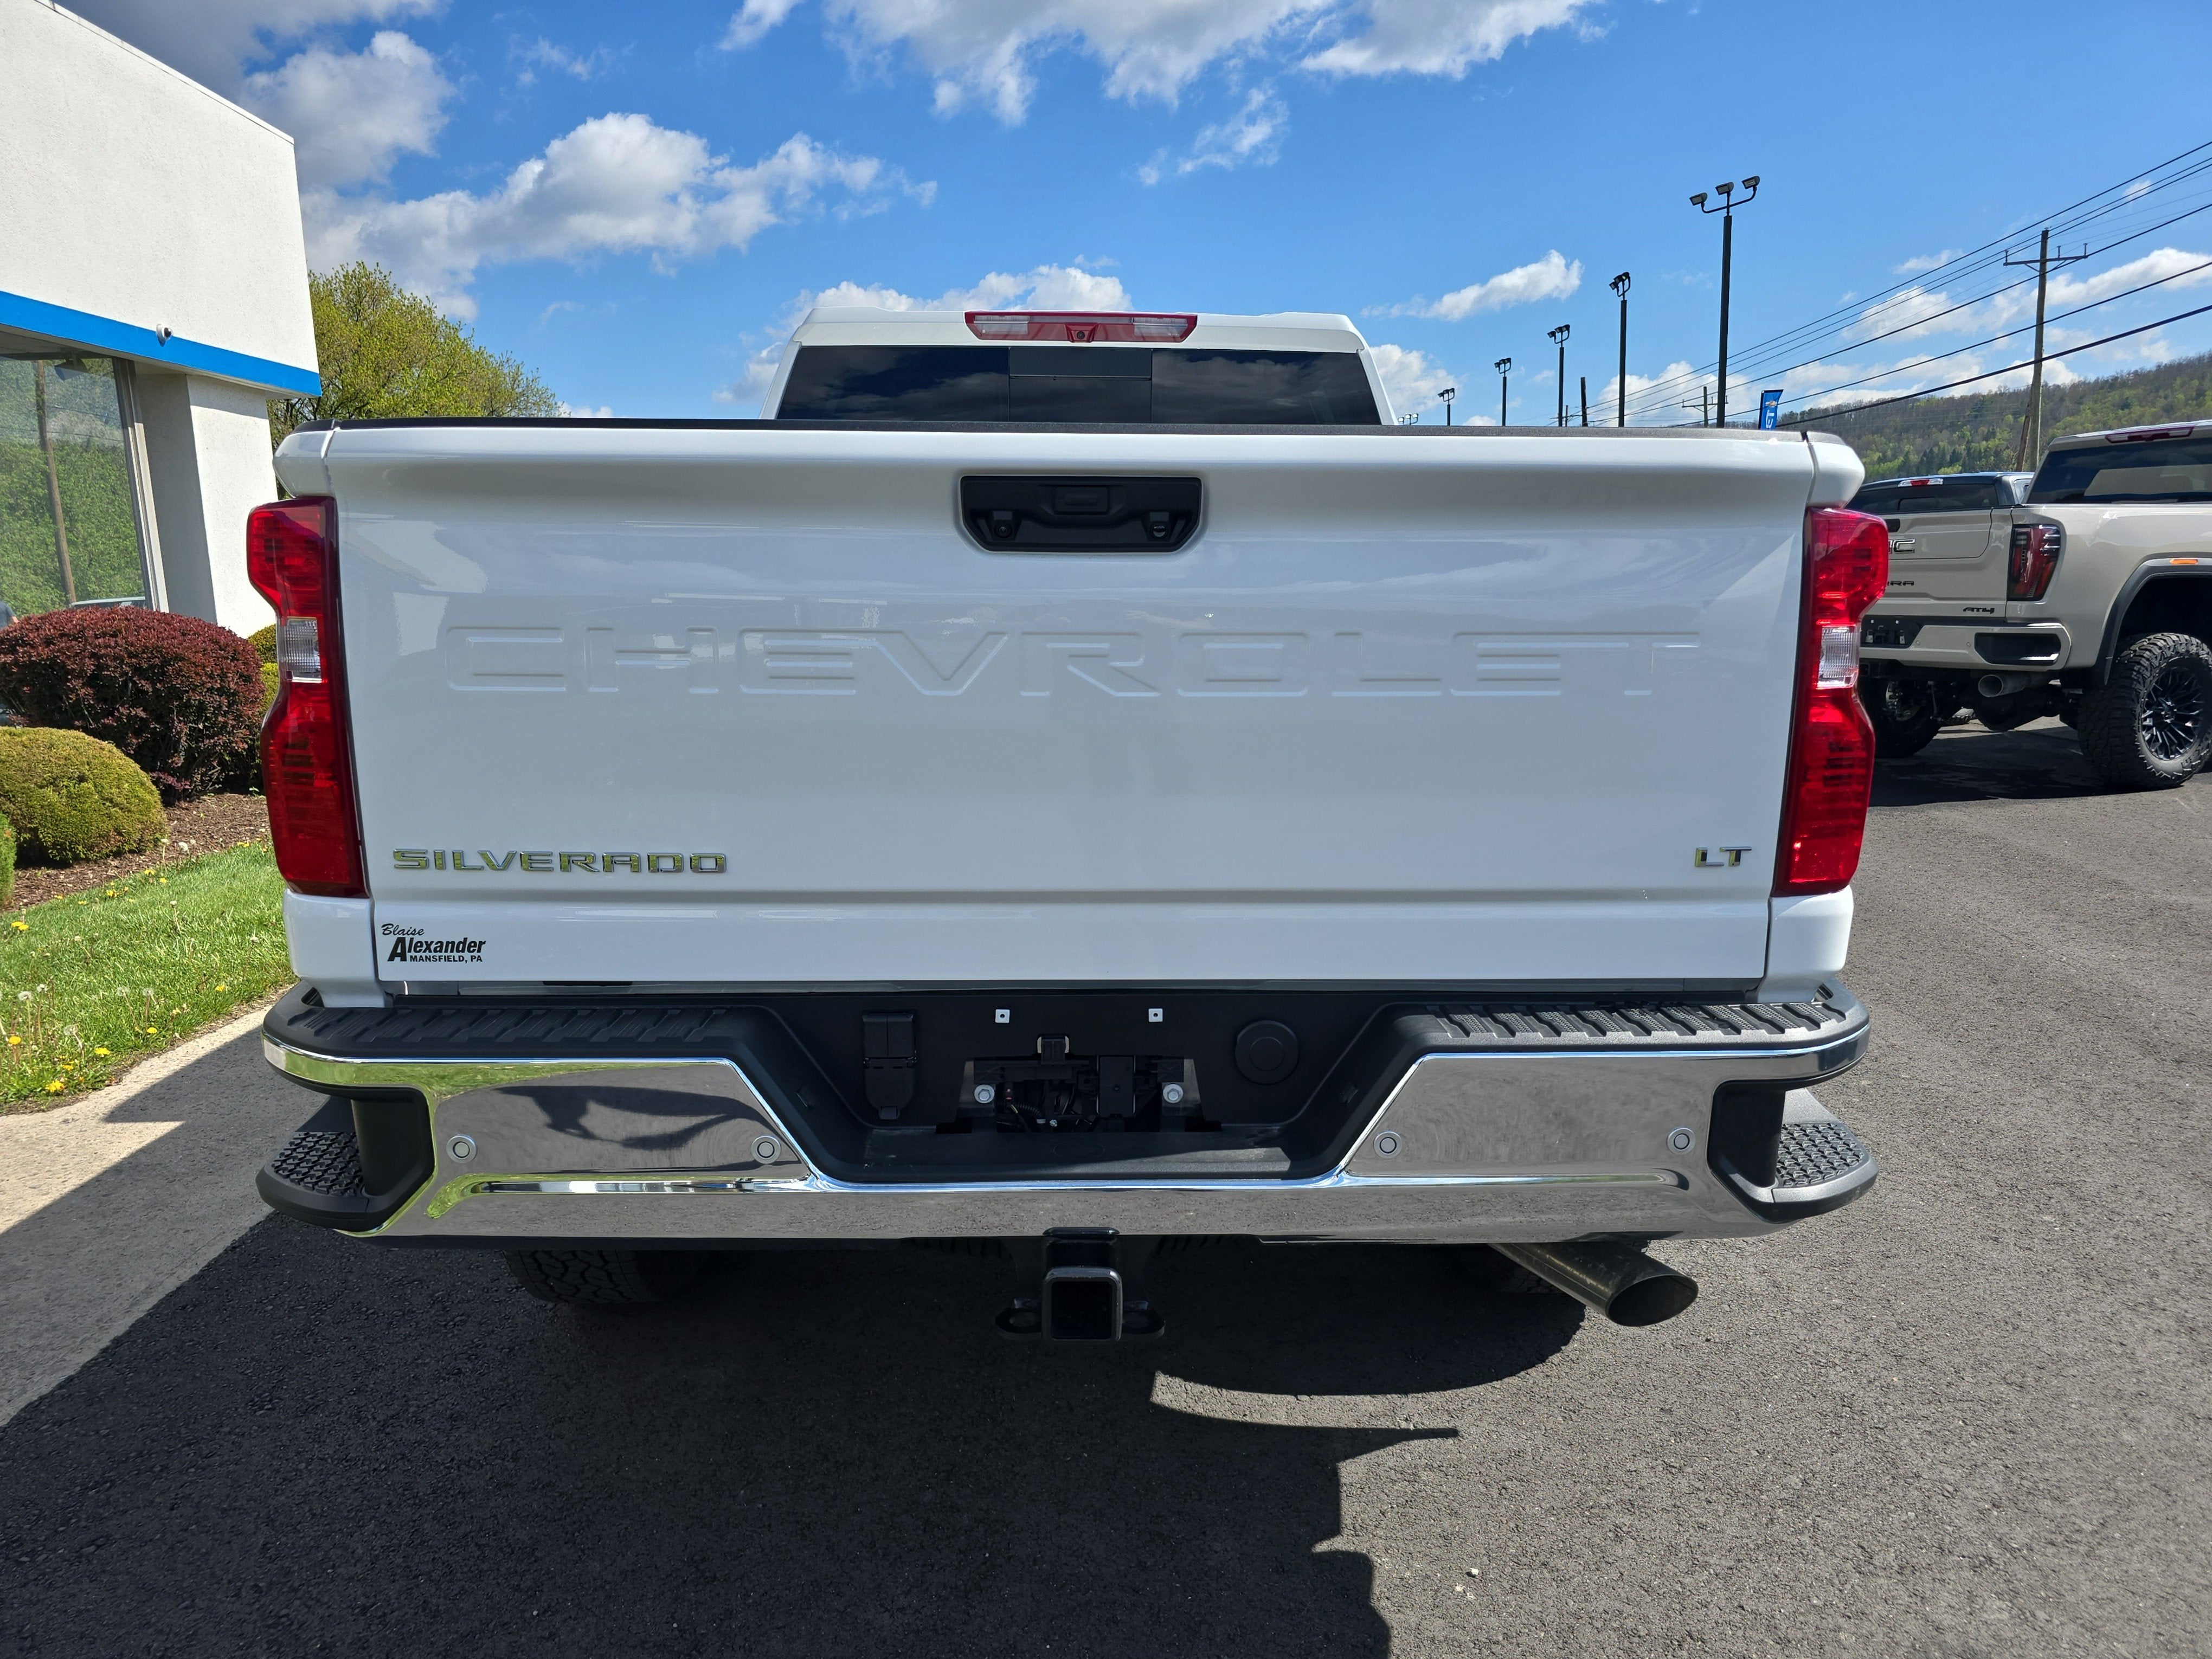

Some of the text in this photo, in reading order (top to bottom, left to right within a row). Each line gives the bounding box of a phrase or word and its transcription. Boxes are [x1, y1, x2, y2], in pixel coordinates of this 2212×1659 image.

[446, 626, 1701, 697] CHEVROLET
[393, 848, 727, 873] SILVERADO
[1695, 846, 1752, 867] LT
[381, 923, 425, 936] Blaise
[387, 937, 486, 962] Alexander
[410, 955, 467, 963] MANSFIELD,
